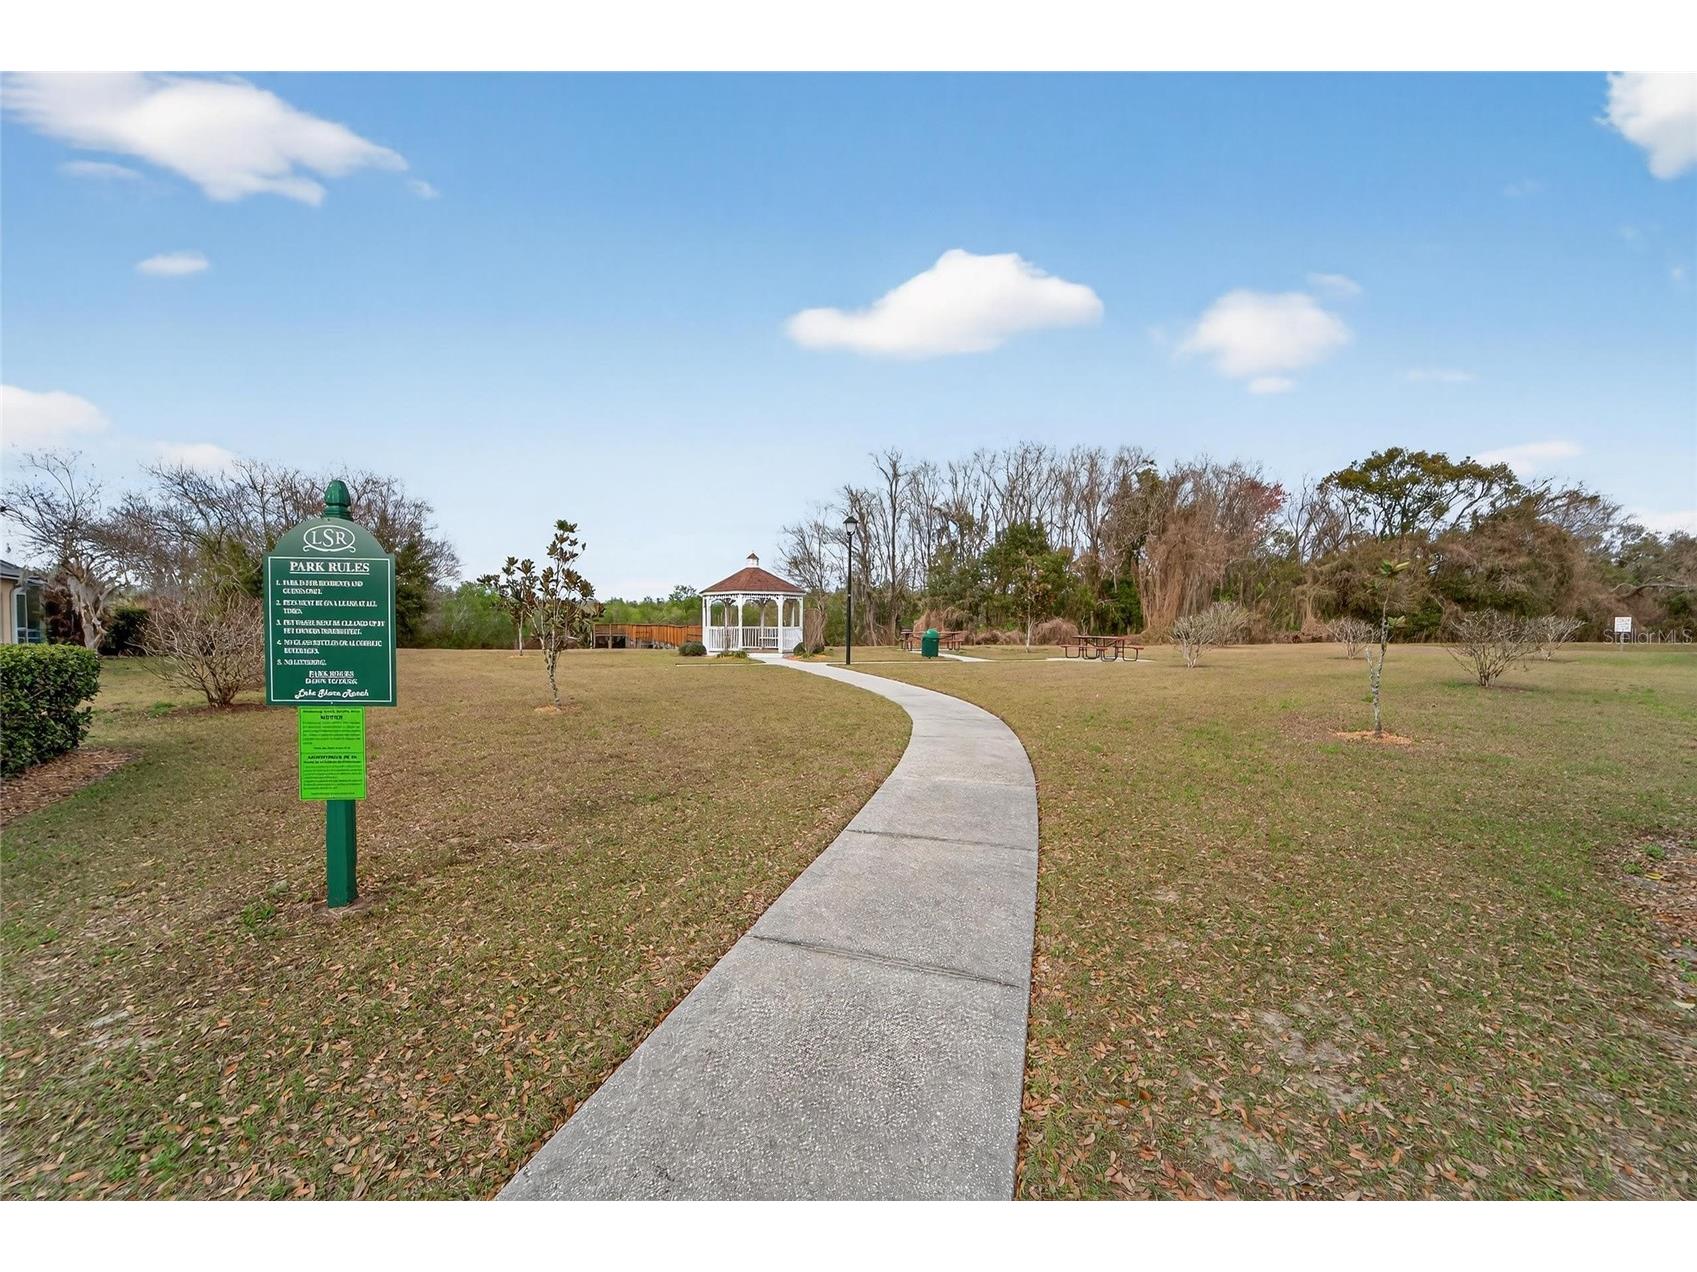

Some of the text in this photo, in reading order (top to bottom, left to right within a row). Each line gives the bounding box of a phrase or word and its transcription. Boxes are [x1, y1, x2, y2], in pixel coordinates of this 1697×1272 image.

[312, 528, 347, 547] LSR
[290, 561, 370, 573] PARK RULES
[295, 689, 316, 699] Lake
[342, 689, 369, 698] Ranch
